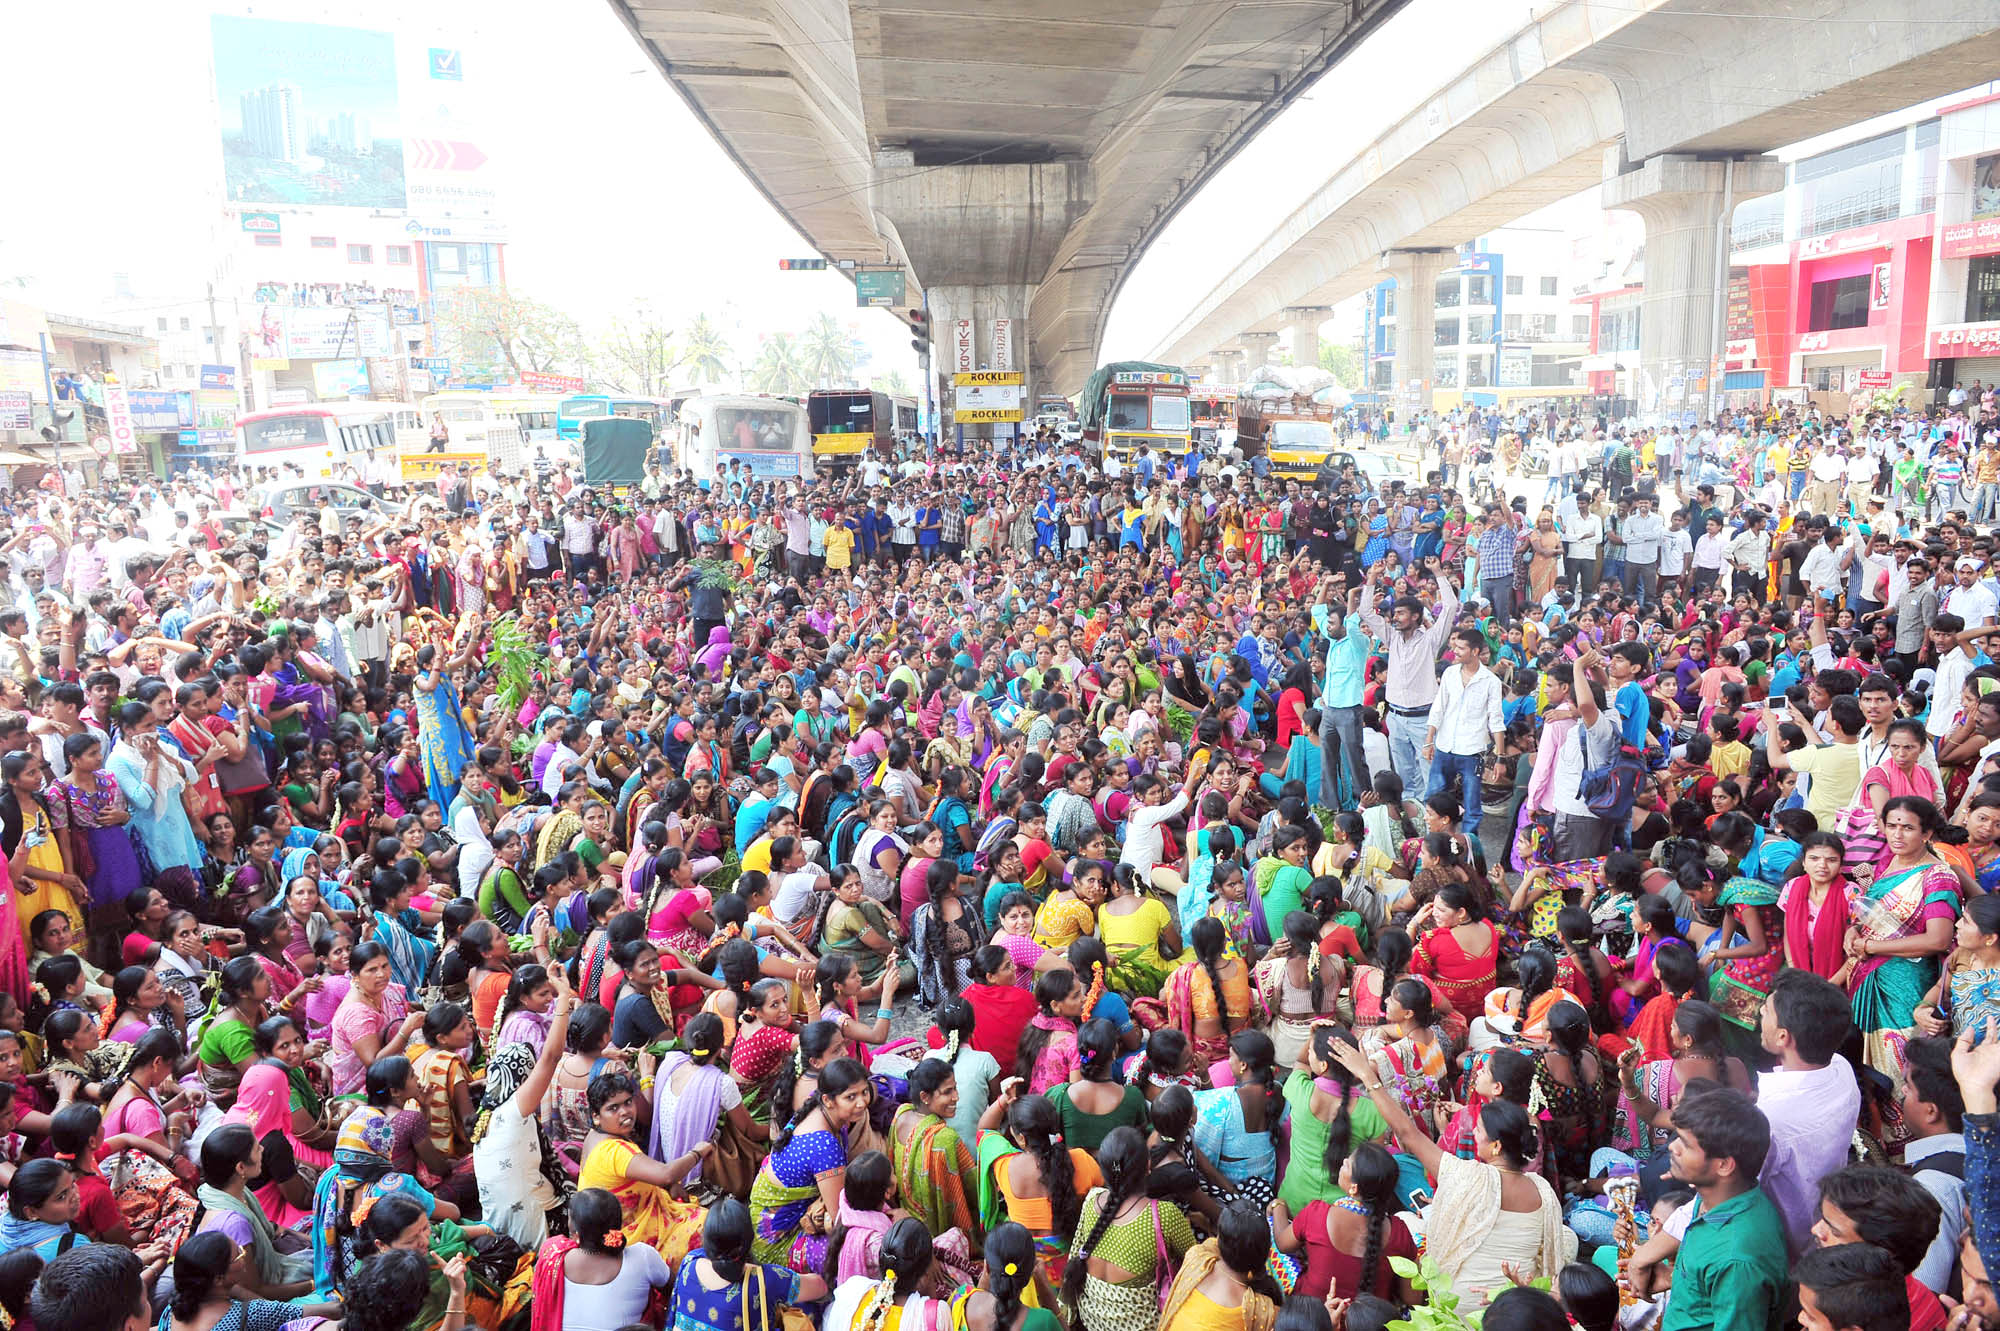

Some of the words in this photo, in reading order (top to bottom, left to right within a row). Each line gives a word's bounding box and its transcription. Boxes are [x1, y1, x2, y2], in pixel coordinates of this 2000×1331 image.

[1799, 234, 1833, 256] KFC
[971, 372, 1019, 381] ROCKLINE
[971, 410, 1020, 418] ROCKLINE
[107, 391, 133, 453] XEROX
